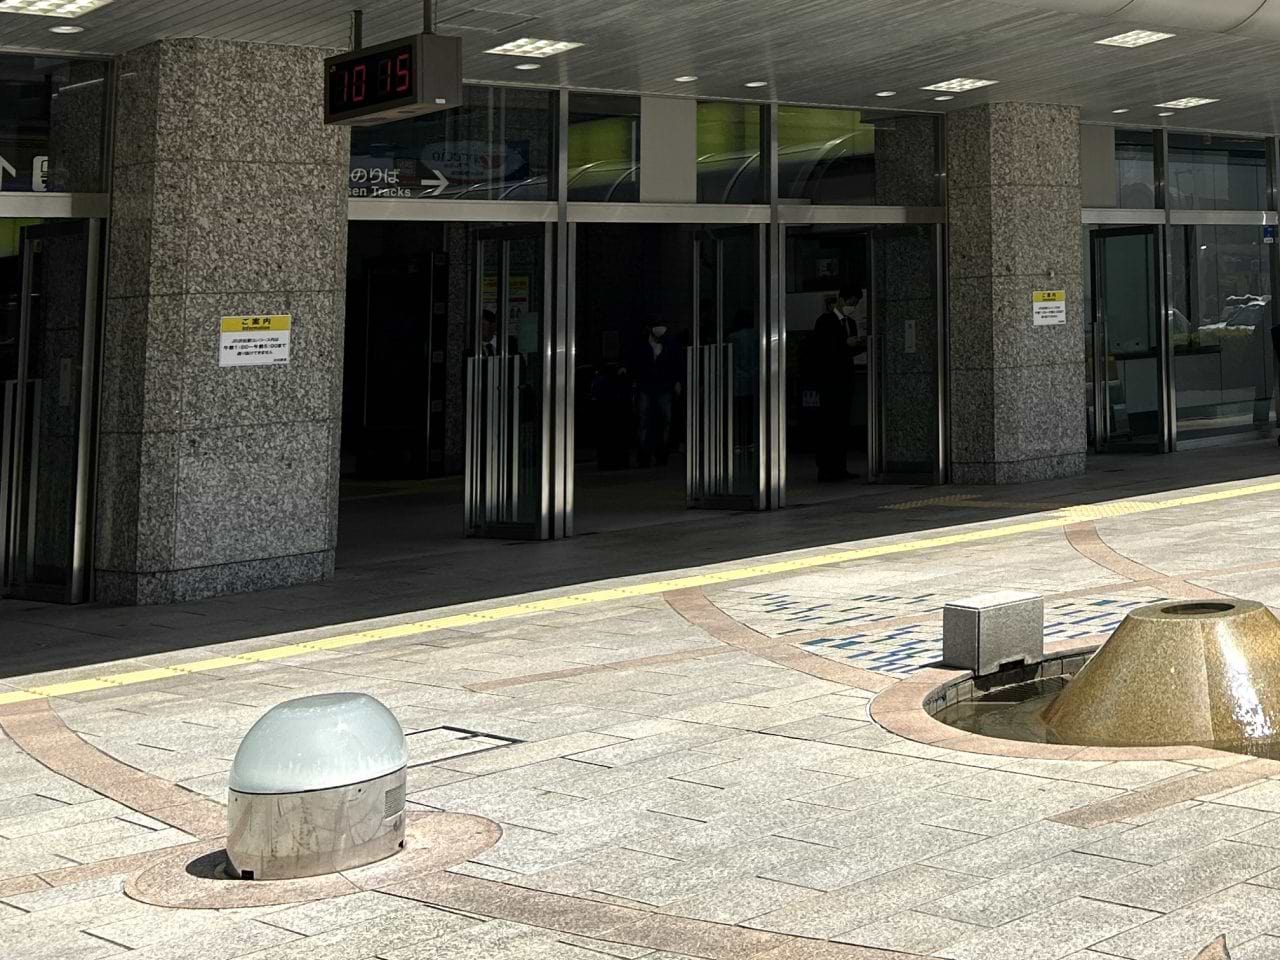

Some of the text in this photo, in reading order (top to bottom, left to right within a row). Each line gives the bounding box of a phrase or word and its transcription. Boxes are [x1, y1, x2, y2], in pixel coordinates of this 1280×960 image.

[343, 53, 409, 102] 10 15
[350, 167, 401, 184] のりば
[371, 185, 411, 197] Tracks
[241, 317, 271, 325] ご案内
